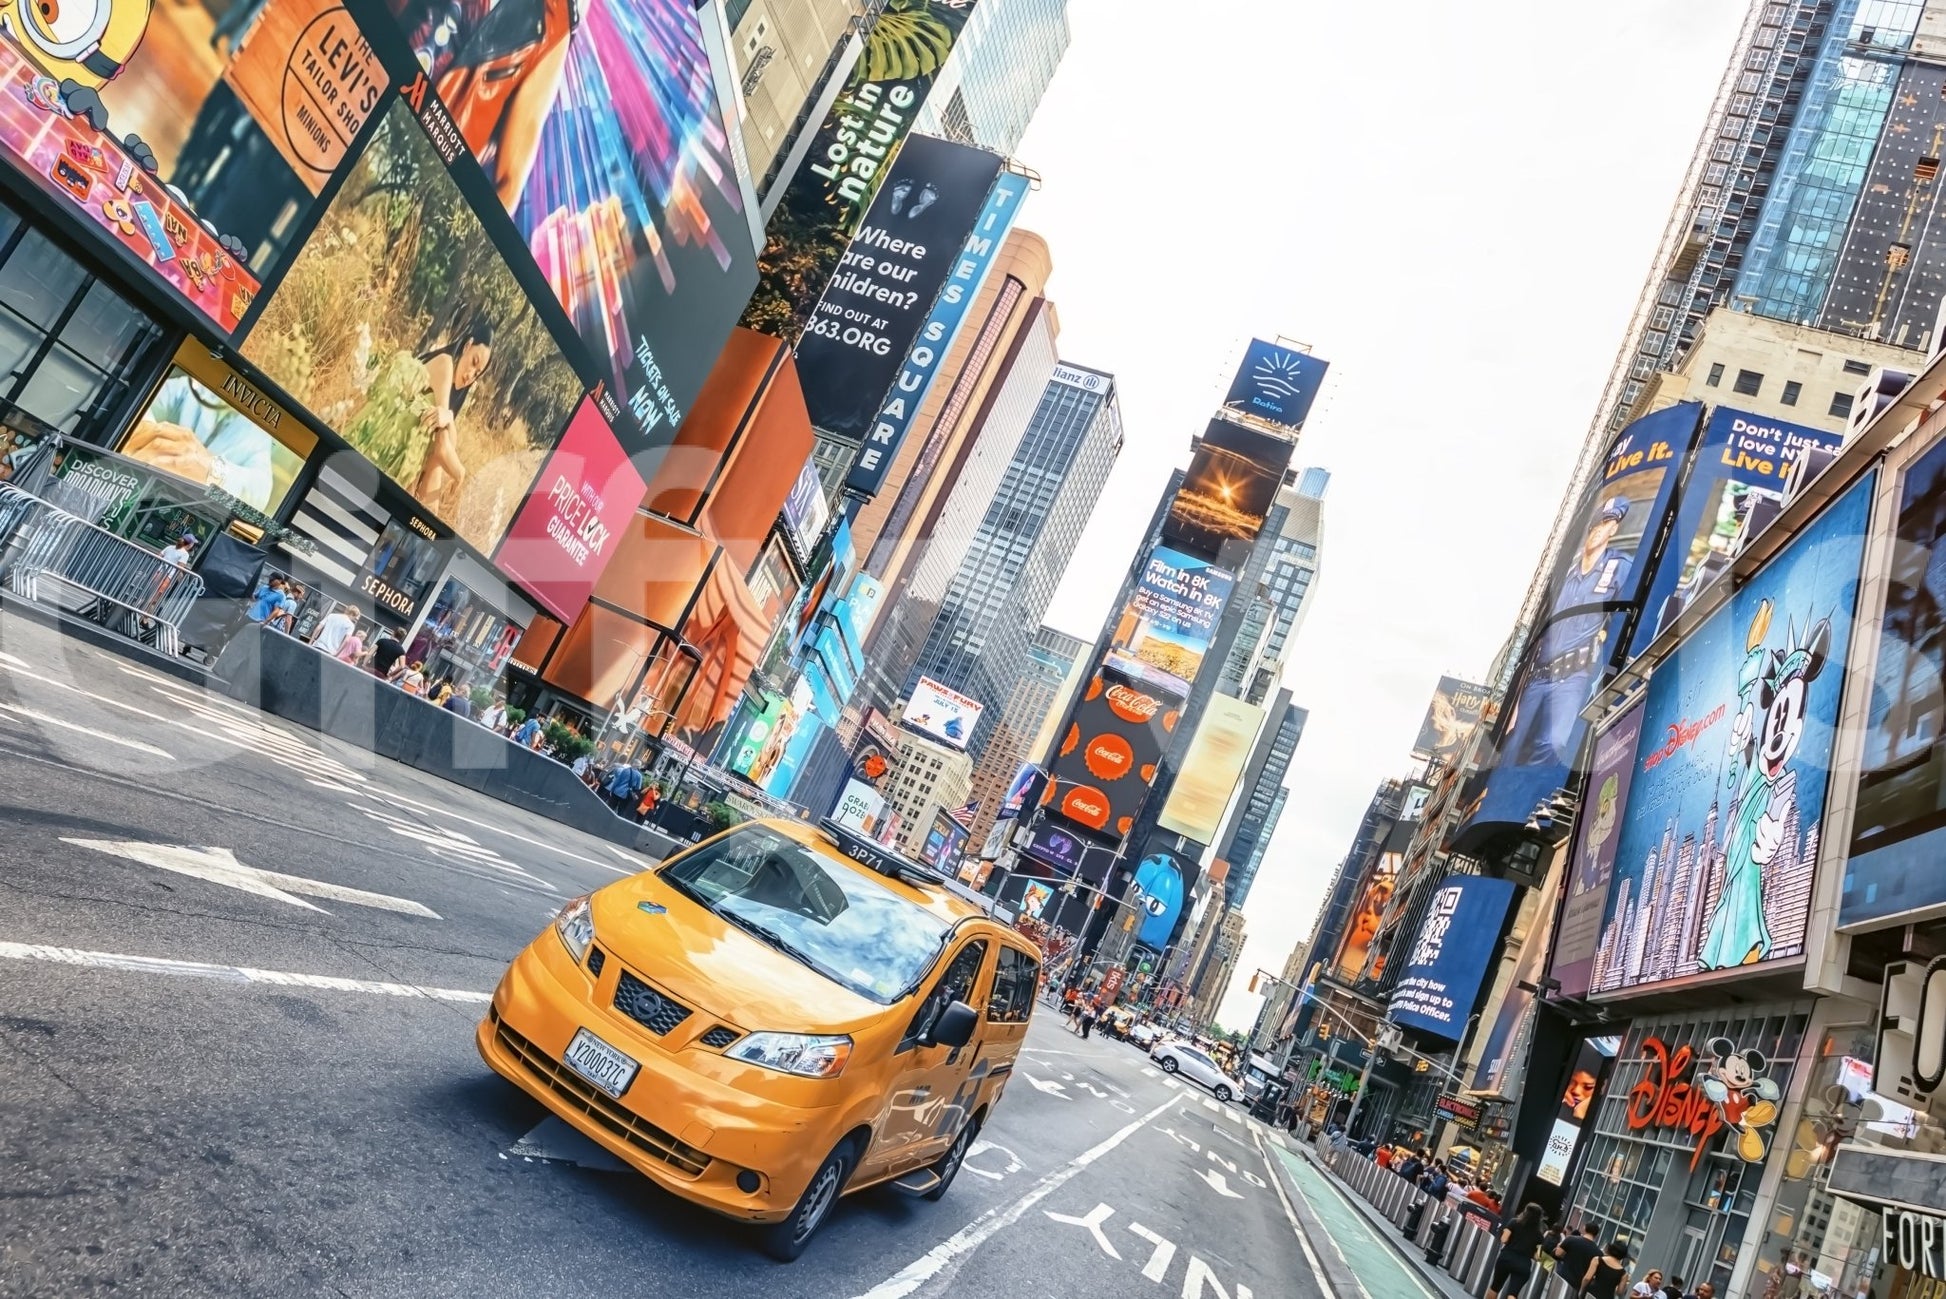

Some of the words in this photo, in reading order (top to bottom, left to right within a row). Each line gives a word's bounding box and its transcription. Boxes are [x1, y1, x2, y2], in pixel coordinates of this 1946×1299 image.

[354, 33, 376, 66] THE
[319, 24, 378, 114] LEVI'S
[302, 49, 338, 105] TAILOR
[337, 102, 360, 135] SHO
[297, 105, 331, 153] MINIONS
[423, 112, 455, 162] MARQUIS
[431, 100, 466, 156] MARRIOTT
[810, 114, 864, 180] Lost
[843, 83, 882, 112] in
[837, 85, 914, 202] nature
[855, 226, 926, 260] Where
[943, 188, 1013, 305] TIMES
[841, 251, 875, 271] are
[877, 261, 918, 283] our
[832, 272, 919, 311] hildren?
[816, 300, 843, 316] FIND
[844, 309, 871, 324] OUT
[871, 318, 889, 331] AT
[635, 334, 663, 390] TICKETS
[656, 385, 670, 404] ON
[664, 399, 682, 428] SALE
[1052, 368, 1082, 385] lianz
[221, 372, 283, 430] INVICTA
[599, 399, 615, 423] MARQUIS
[603, 391, 621, 417] MARRIOTT
[628, 385, 664, 436] NOW
[860, 321, 946, 472] SQUARE
[1727, 434, 1736, 445] I
[1738, 436, 1774, 456] love
[1733, 419, 1782, 441] Don't
[1786, 431, 1820, 451] just
[1825, 442, 1844, 457] sa
[71, 459, 139, 489] DISCOVER
[1605, 450, 1644, 480] Live
[1647, 441, 1674, 461] it.
[1721, 448, 1774, 475] Live
[580, 480, 594, 500] WITH
[591, 496, 605, 514] OUR
[409, 516, 438, 542] SEPHORA
[547, 475, 586, 527] PRICE
[577, 509, 611, 556] LOCK
[547, 515, 589, 567] GUARANTEE
[1146, 572, 1188, 598] Watch
[1189, 587, 1203, 602] in
[1203, 594, 1223, 610] 8K
[1149, 559, 1176, 578] Film
[1177, 568, 1191, 583] in
[1192, 575, 1211, 591] 8K
[1205, 567, 1233, 582] SAMSUNG
[361, 575, 415, 617] SEPHORA
[1135, 595, 1149, 604] get
[1149, 599, 1160, 608] an
[1160, 602, 1177, 614] epic
[1177, 609, 1211, 629] Samsung
[1138, 586, 1153, 597] Buy
[1159, 594, 1194, 614] Samsung
[1194, 606, 1203, 616] 8K
[1133, 600, 1159, 616] Galaxy
[1159, 610, 1171, 620] S22
[1171, 616, 1182, 625] on
[1182, 619, 1192, 628] us
[920, 677, 948, 695] PAWS
[953, 695, 983, 712] FURY
[933, 697, 950, 710] JULY
[951, 706, 959, 714] 15
[1105, 684, 1164, 717] Coca-Cola
[1451, 692, 1481, 709] Harry
[1094, 746, 1126, 765] Coca-Cola
[1071, 798, 1102, 817] Coca-Cola
[848, 844, 884, 871] 3P71
[1106, 970, 1122, 991] tkts
[1416, 977, 1429, 989] city
[1428, 980, 1446, 993] how
[1415, 990, 1430, 1001] sign
[1430, 995, 1442, 1006] up
[1442, 997, 1454, 1009] to
[1420, 1005, 1452, 1023] Officer.
[572, 1040, 626, 1086] Y200037C
[591, 1039, 604, 1051] NEW
[606, 1049, 623, 1062] YORK
[586, 1070, 599, 1080] TAXI
[1042, 1202, 1254, 1299] NLY
[1882, 1205, 1946, 1278] FOR
